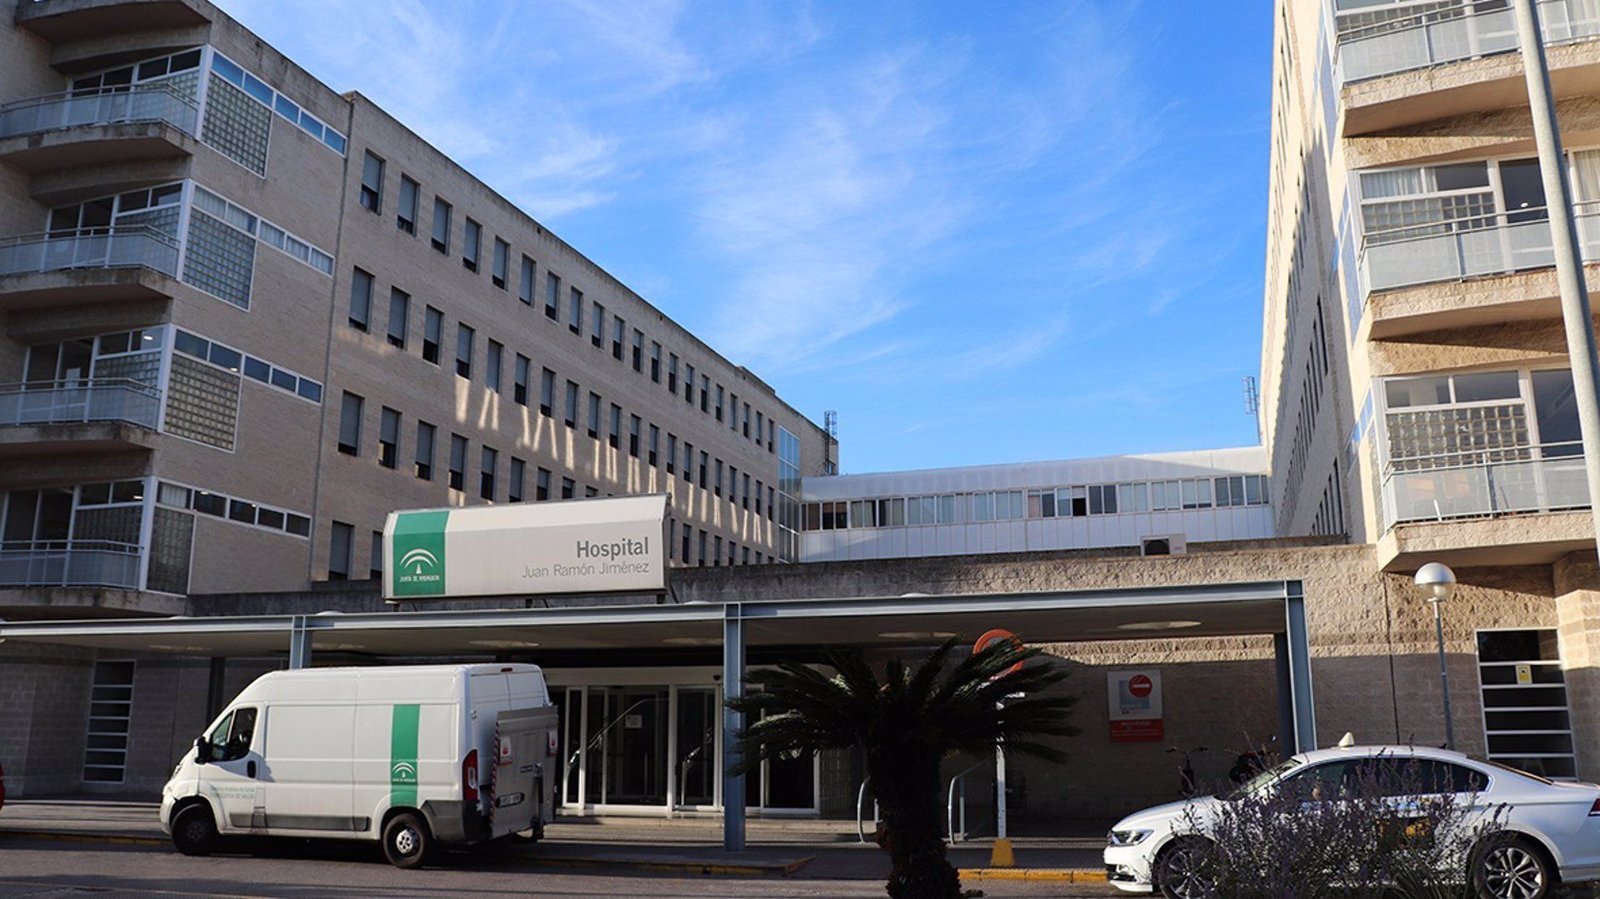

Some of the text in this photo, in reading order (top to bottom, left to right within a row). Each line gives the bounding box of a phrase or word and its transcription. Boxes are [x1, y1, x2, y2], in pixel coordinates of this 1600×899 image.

[577, 537, 648, 560] Hospital
[522, 562, 649, 578] Juan Ramón Jiménez
